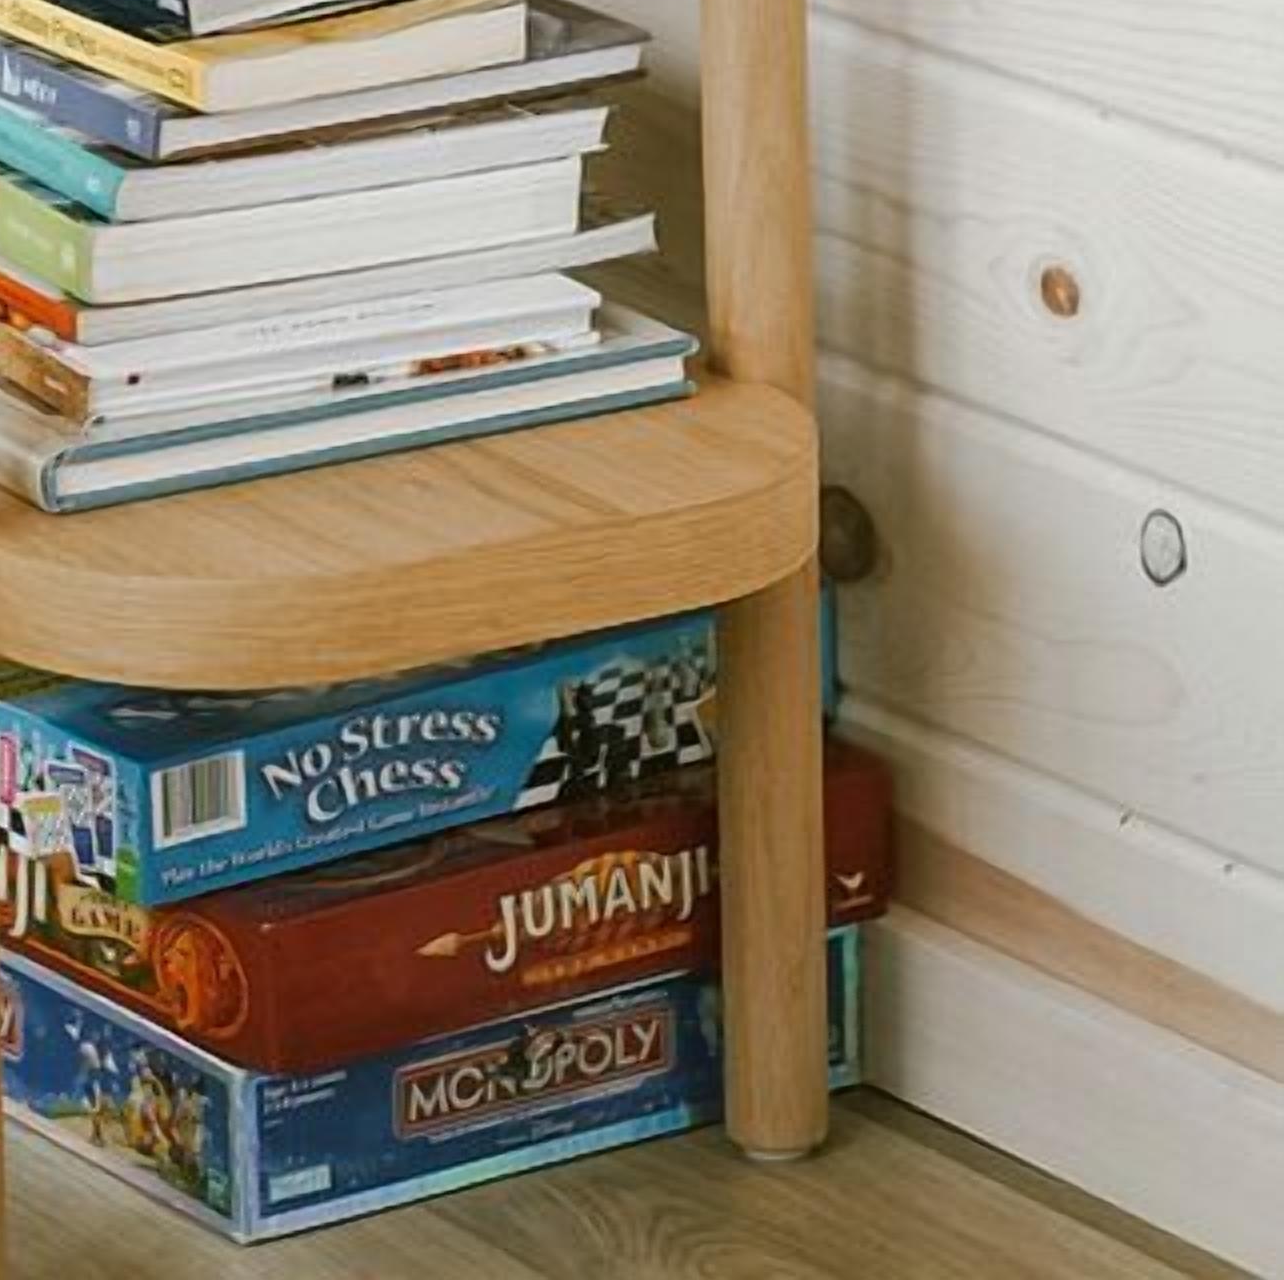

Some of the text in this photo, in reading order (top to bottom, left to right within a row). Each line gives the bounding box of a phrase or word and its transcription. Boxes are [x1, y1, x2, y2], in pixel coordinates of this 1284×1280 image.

[336, 708, 500, 762] Stress
[307, 757, 464, 823] Chess
[485, 845, 708, 973] JUMANJI
